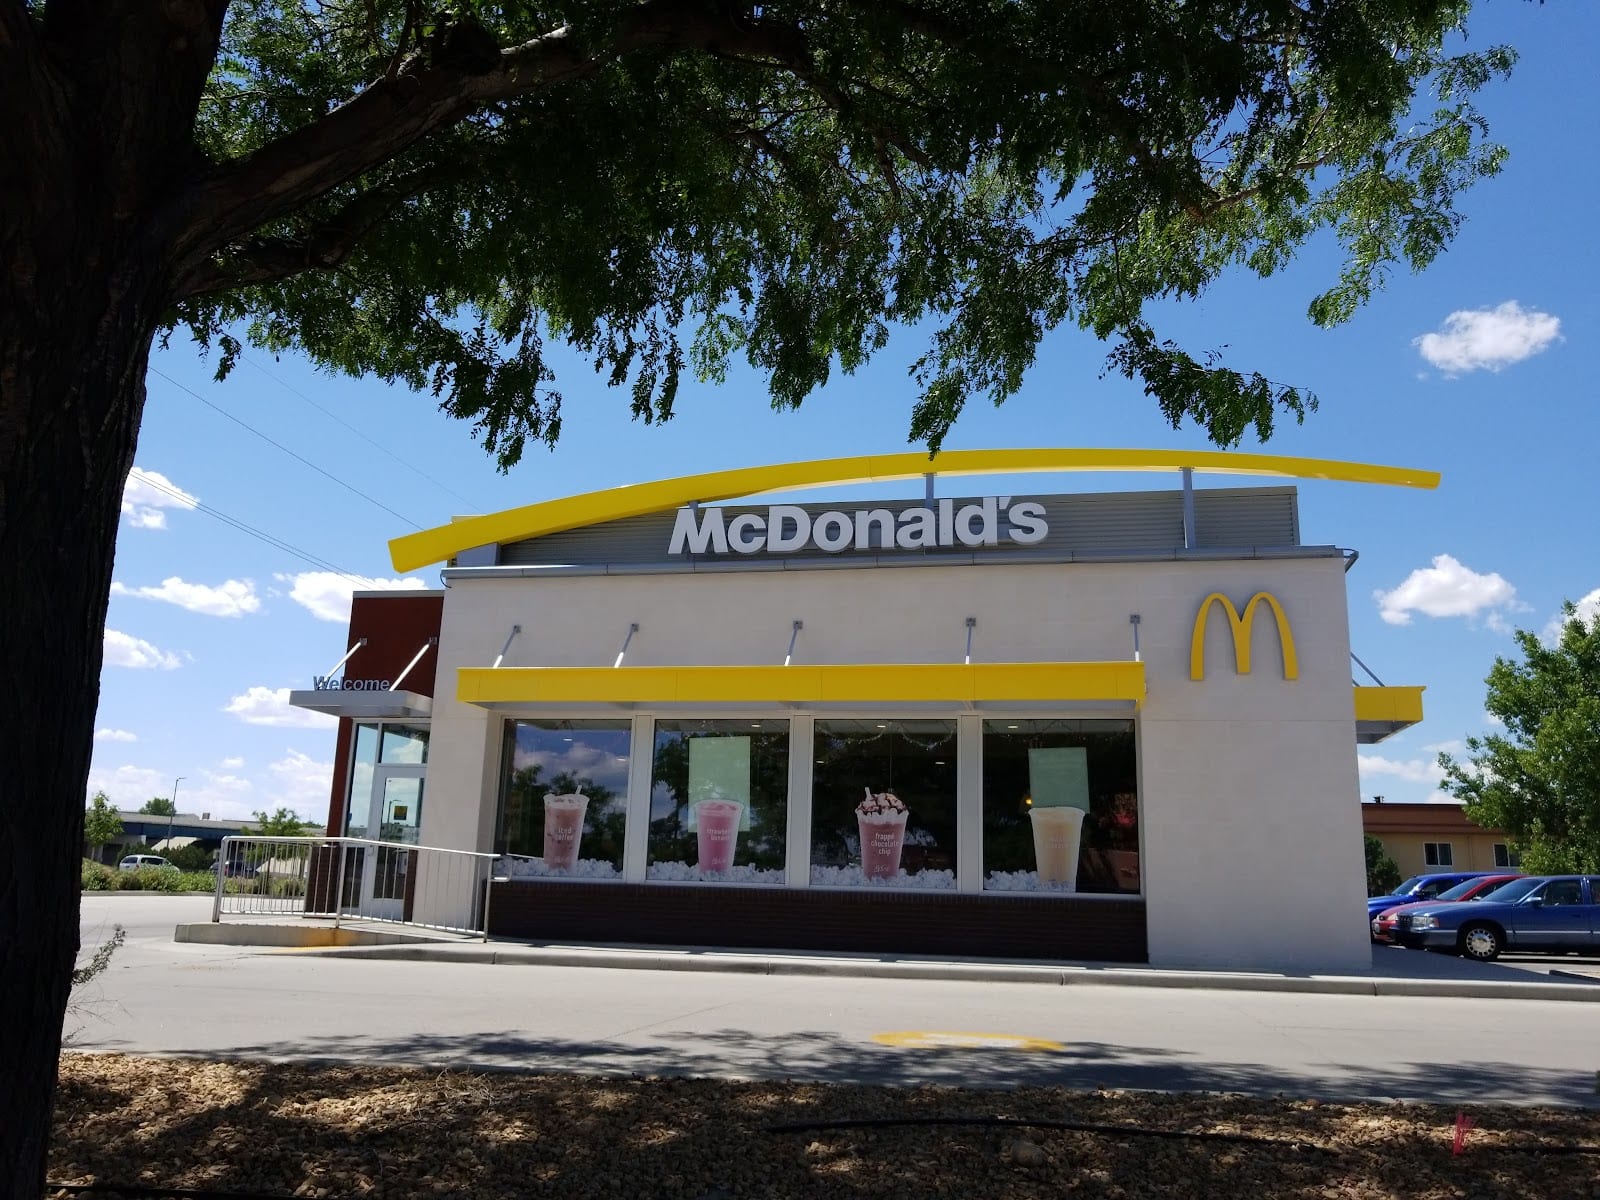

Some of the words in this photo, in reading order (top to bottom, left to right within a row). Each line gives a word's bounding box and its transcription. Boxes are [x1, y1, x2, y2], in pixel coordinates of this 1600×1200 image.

[667, 496, 1049, 555] McDonald's
[313, 676, 390, 691] Welcome
[871, 840, 899, 848] chocolate
[878, 848, 891, 856] chip
